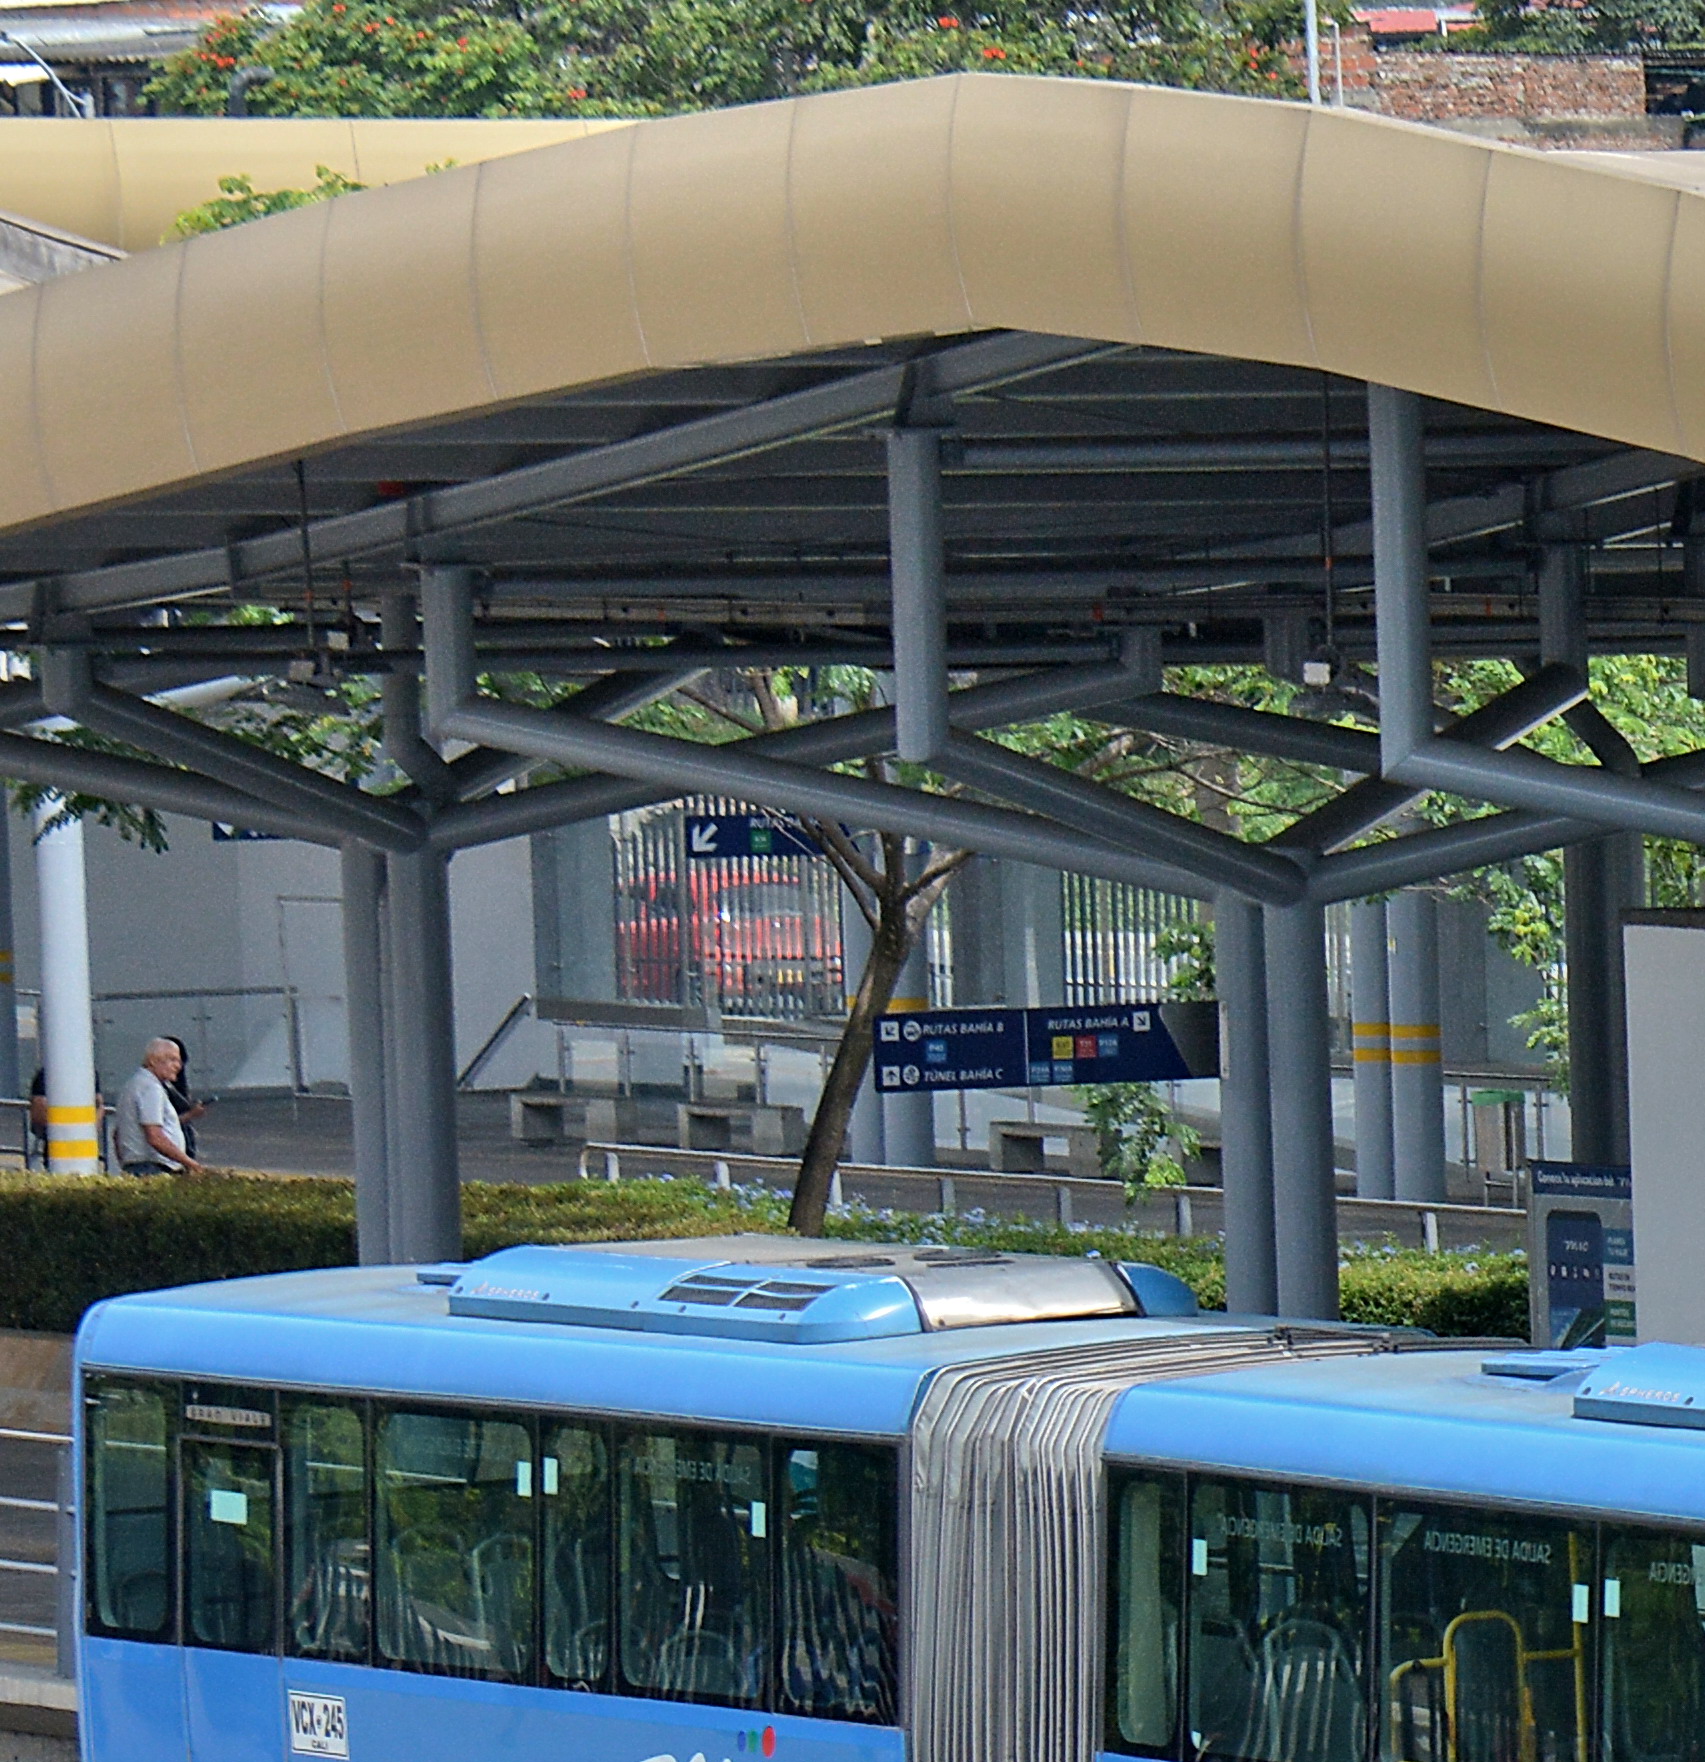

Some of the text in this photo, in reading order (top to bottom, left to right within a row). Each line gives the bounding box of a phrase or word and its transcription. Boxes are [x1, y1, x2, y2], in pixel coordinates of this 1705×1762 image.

[922, 1023, 957, 1036] RUTAS
[959, 1021, 994, 1035] BAHÍA
[1047, 1015, 1130, 1031] RUTAS BAHÍA A
[924, 1067, 1004, 1082] TÚNEL BAHÍA C
